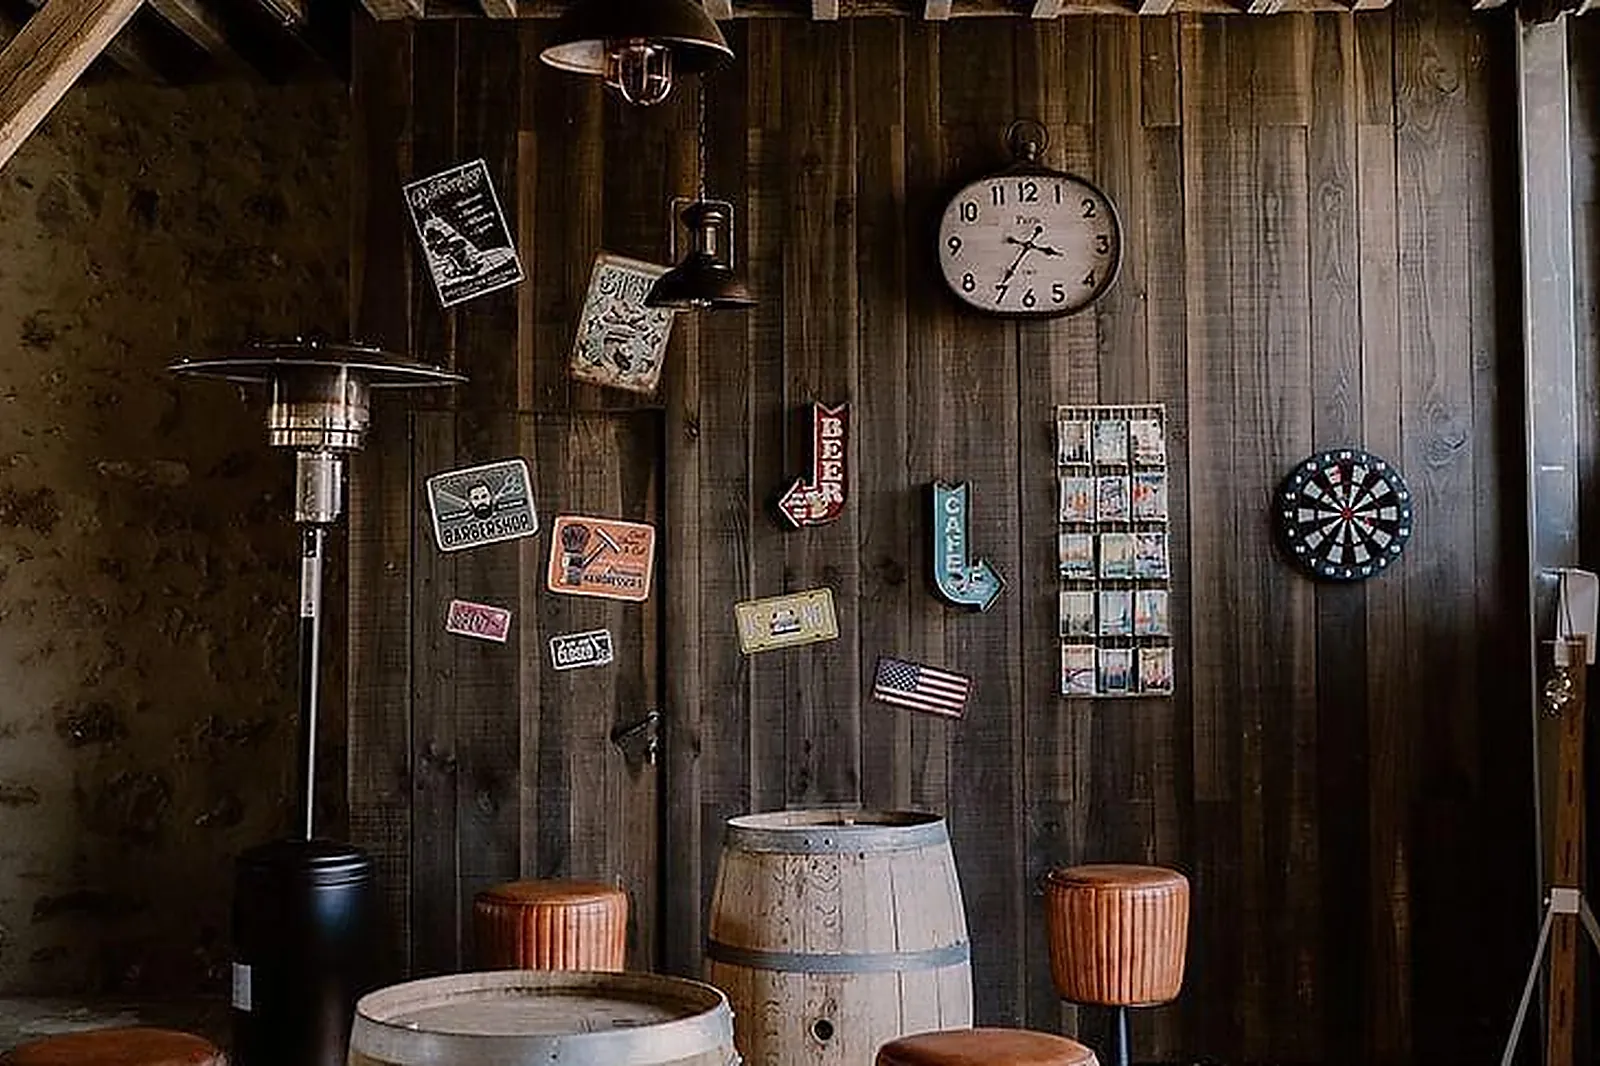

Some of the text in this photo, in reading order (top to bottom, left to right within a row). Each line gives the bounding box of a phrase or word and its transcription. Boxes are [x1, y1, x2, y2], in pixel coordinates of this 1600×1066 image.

[992, 186, 1005, 206] 11
[1018, 182, 1038, 202] 12
[1055, 184, 1061, 204] 1
[960, 202, 978, 222] 10
[1081, 199, 1096, 218] 2
[947, 236, 962, 255] 9
[1096, 235, 1109, 254] 3
[962, 272, 975, 292] 8
[1082, 269, 1095, 288] 4
[995, 284, 1008, 304] 7
[1022, 288, 1036, 308] 6
[1052, 284, 1065, 303] 5
[820, 417, 844, 503] BEER
[443, 513, 529, 545] BARBERSHOP
[944, 496, 962, 574] CAFE
